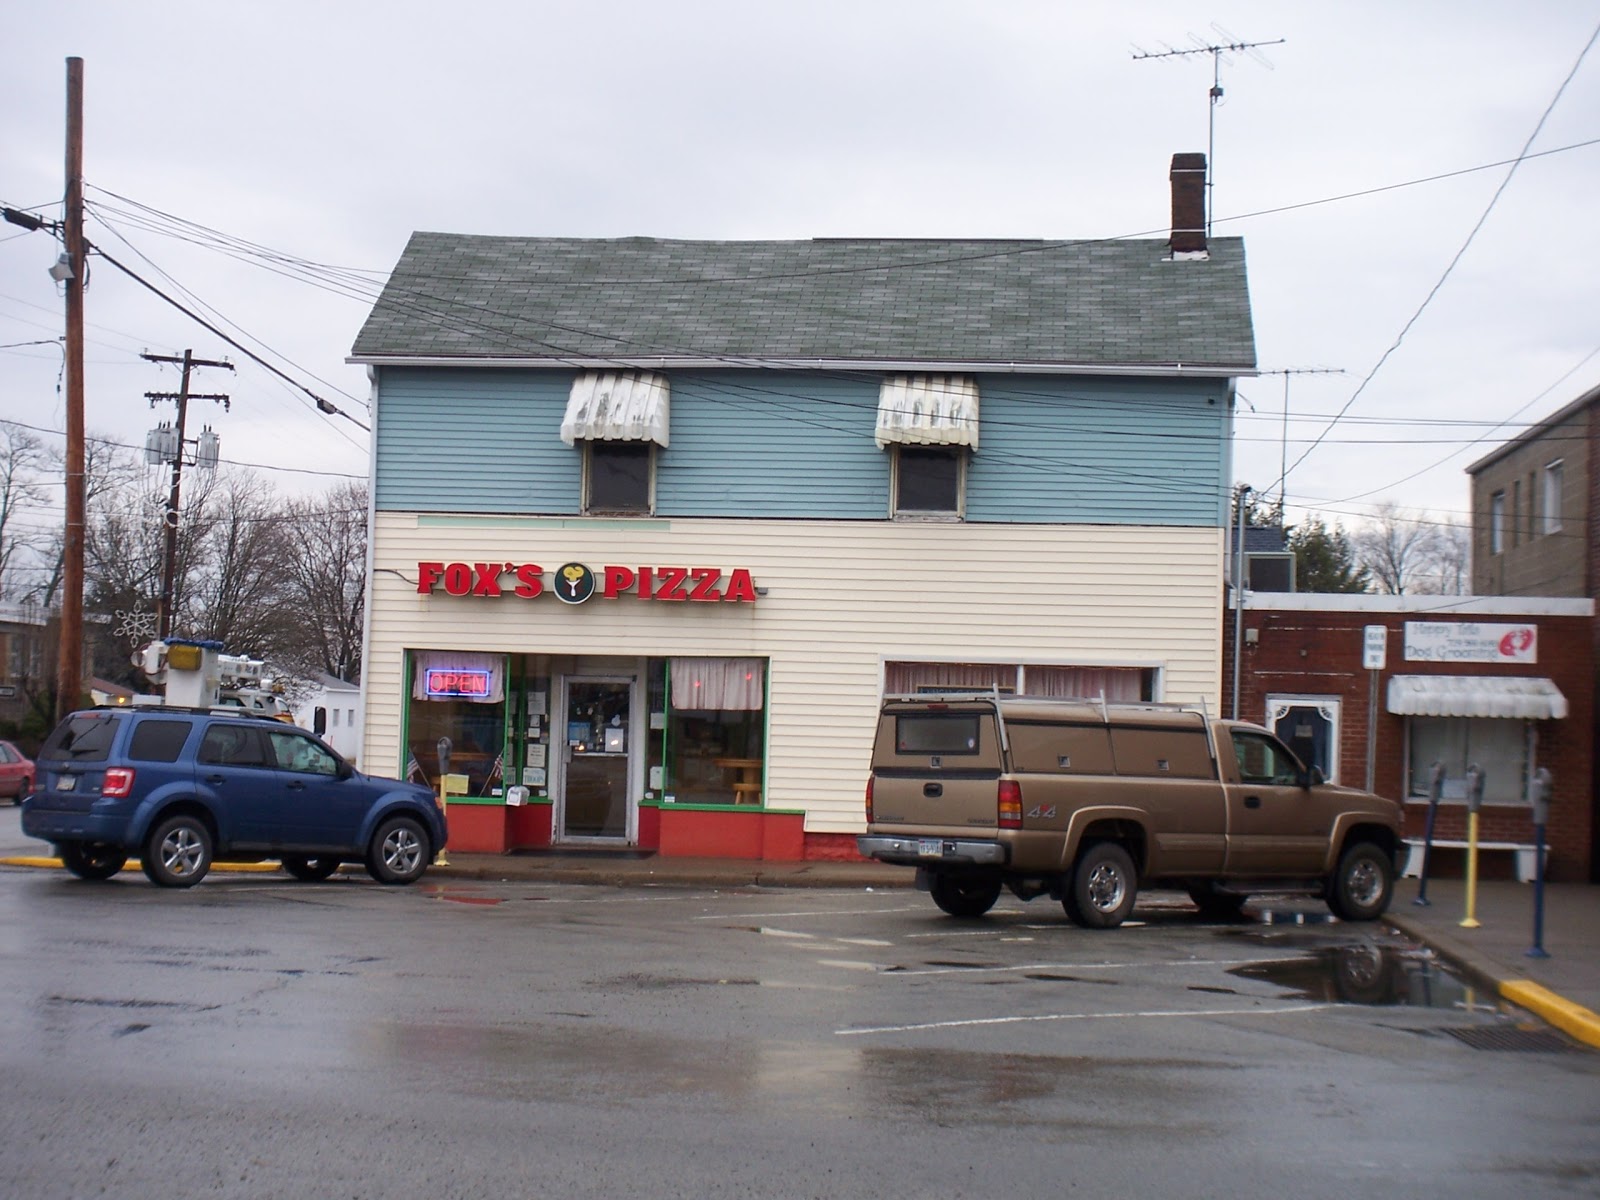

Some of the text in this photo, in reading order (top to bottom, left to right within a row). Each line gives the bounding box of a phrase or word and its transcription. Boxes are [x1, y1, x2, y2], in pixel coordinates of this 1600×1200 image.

[417, 562, 756, 603] FOX'S PIZZA
[430, 673, 486, 693] OPEN
